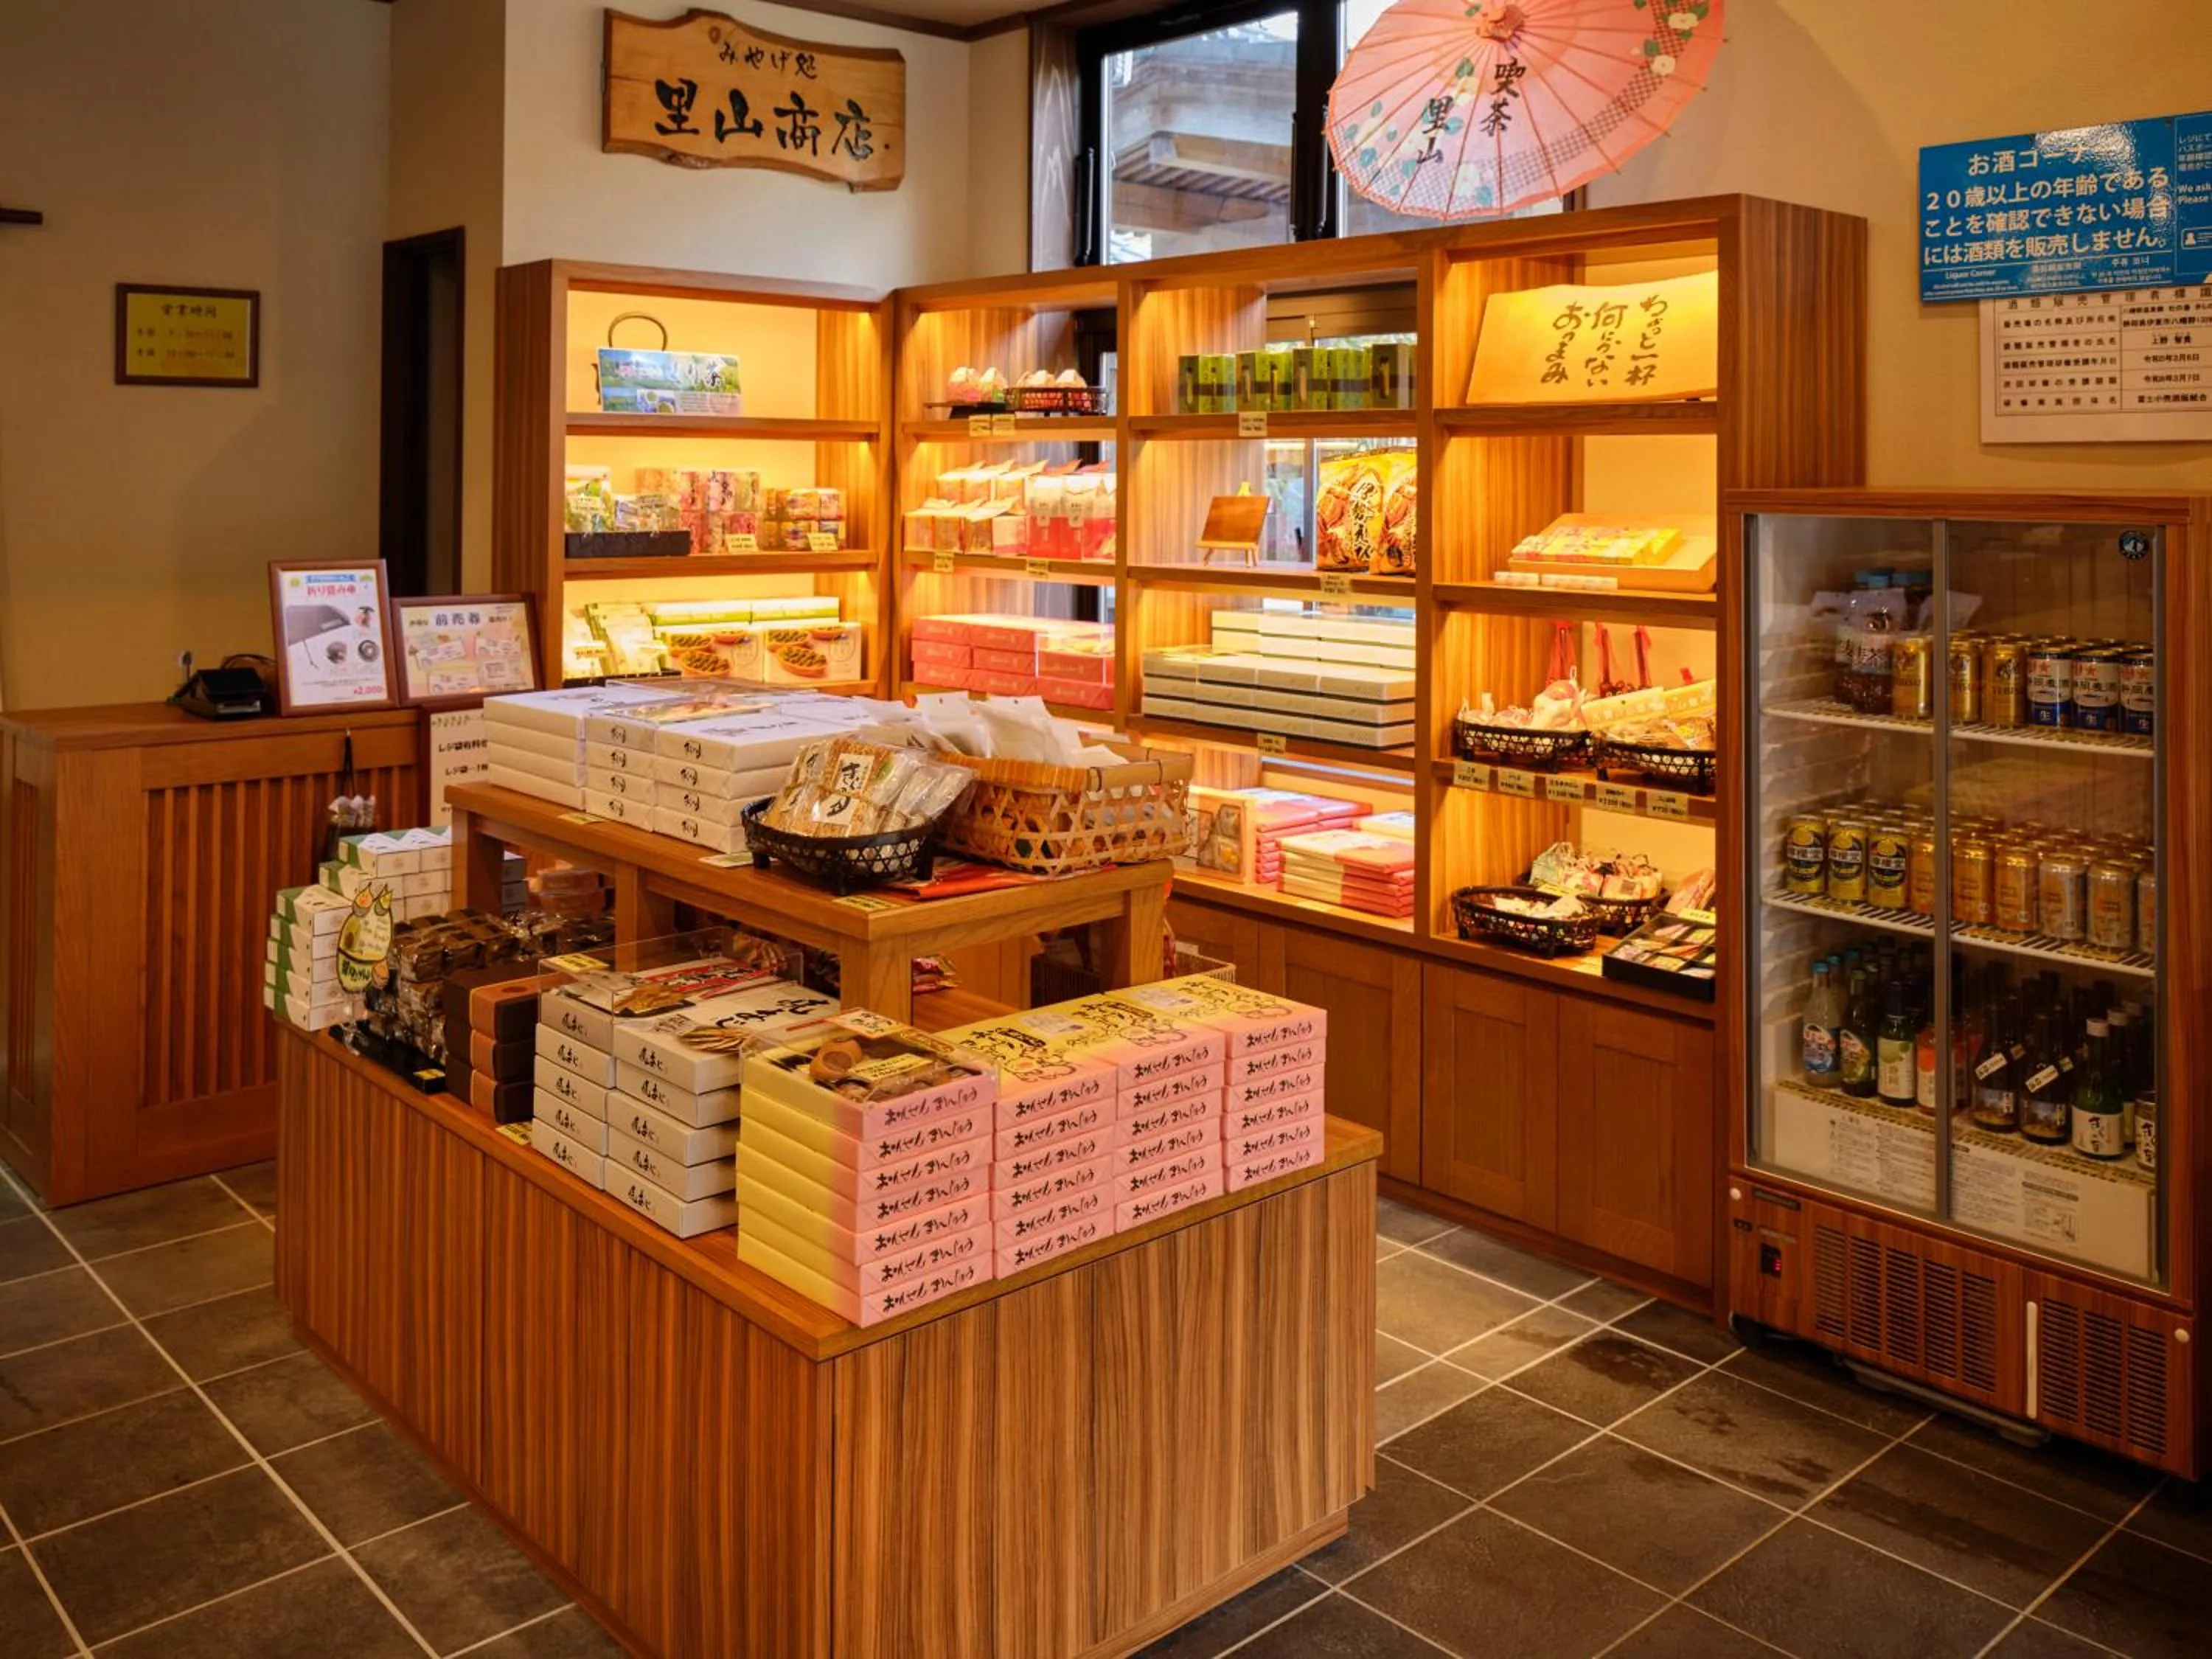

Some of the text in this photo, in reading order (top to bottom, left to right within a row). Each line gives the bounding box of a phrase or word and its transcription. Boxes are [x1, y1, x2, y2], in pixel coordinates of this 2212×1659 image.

[720, 42, 818, 80] みやげ処
[1481, 58, 1526, 137] 喫茶
[655, 78, 874, 161] 里山商店
[1417, 97, 1454, 164] 里山
[1969, 144, 2115, 176] お酒コーナ
[1926, 167, 2169, 211] 20歳以上の年齢である
[1924, 195, 2169, 238] ことを確認できない場合
[1924, 226, 2166, 265] には酒類を販売しません。
[435, 612, 481, 626] 前売券
